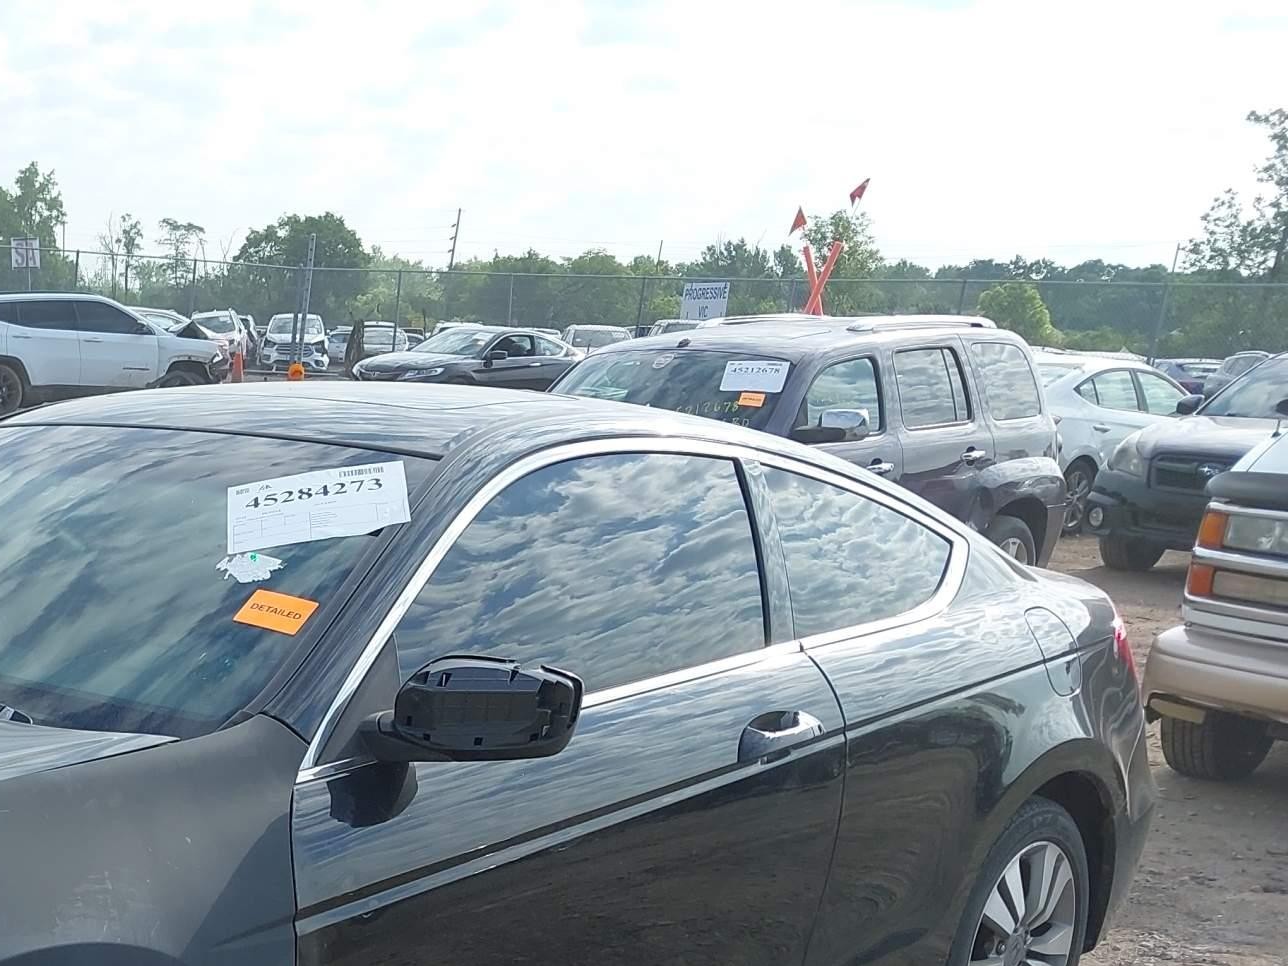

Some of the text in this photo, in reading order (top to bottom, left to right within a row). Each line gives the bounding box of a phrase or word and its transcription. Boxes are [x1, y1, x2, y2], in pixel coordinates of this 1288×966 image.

[685, 286, 727, 300] PROGRESSIVE
[245, 478, 383, 509] 45284273
[249, 602, 303, 621] DETAILED
